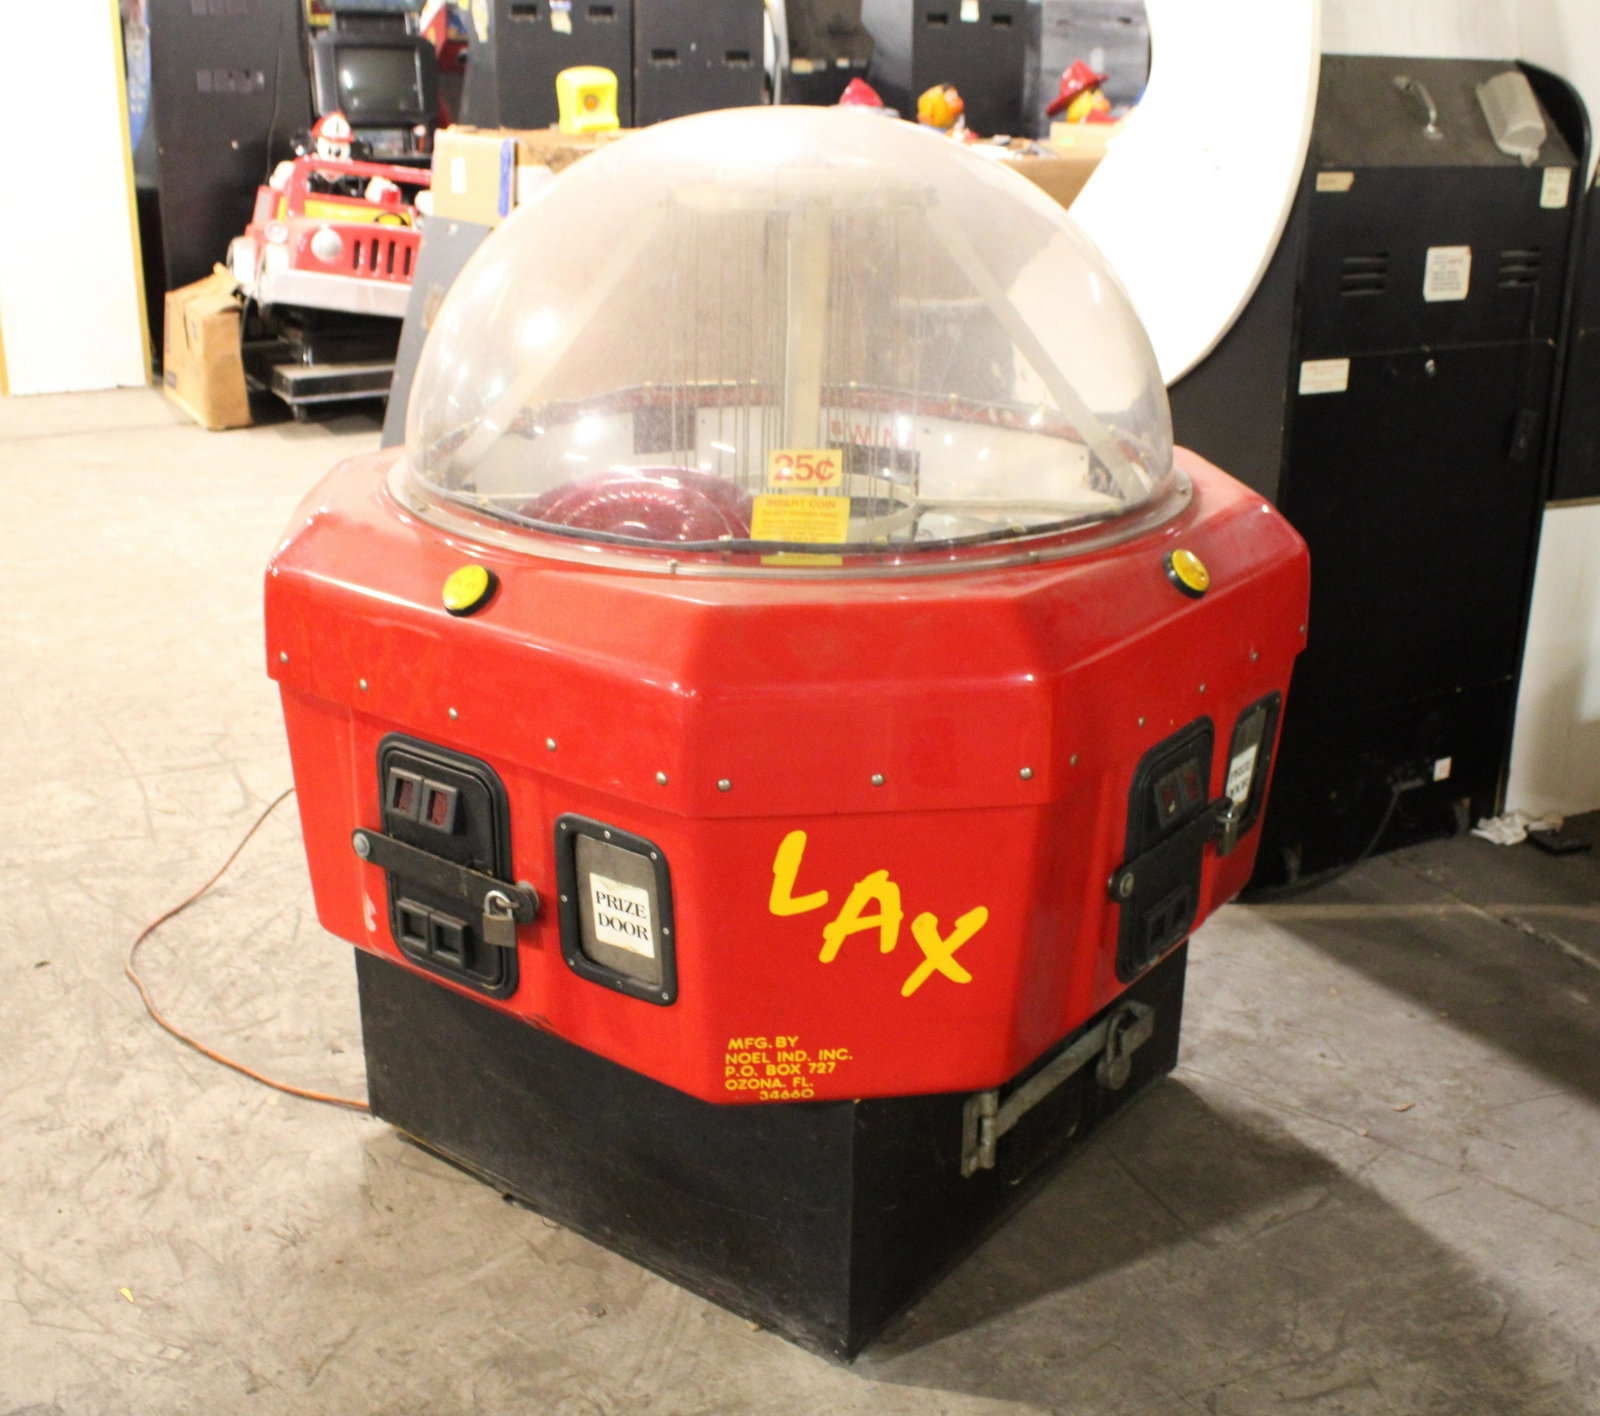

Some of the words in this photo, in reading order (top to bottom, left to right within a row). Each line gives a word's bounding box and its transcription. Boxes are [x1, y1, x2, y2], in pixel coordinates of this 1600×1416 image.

[774, 454, 835, 485] 25¢
[809, 499, 836, 509] COIN
[596, 890, 646, 919] PRIZE
[769, 830, 989, 997] LAX
[598, 912, 649, 941] DOOR
[727, 1037, 773, 1050] MFG.
[775, 1035, 799, 1048] BY
[725, 1052, 771, 1064] NOEL
[777, 1050, 812, 1062] IND.
[818, 1048, 853, 1061] INC.
[725, 1065, 759, 1077] P.O.
[766, 1063, 801, 1076] BOX
[808, 1061, 836, 1074] 727
[793, 1076, 814, 1088] FL.
[759, 1088, 815, 1100] 34660
